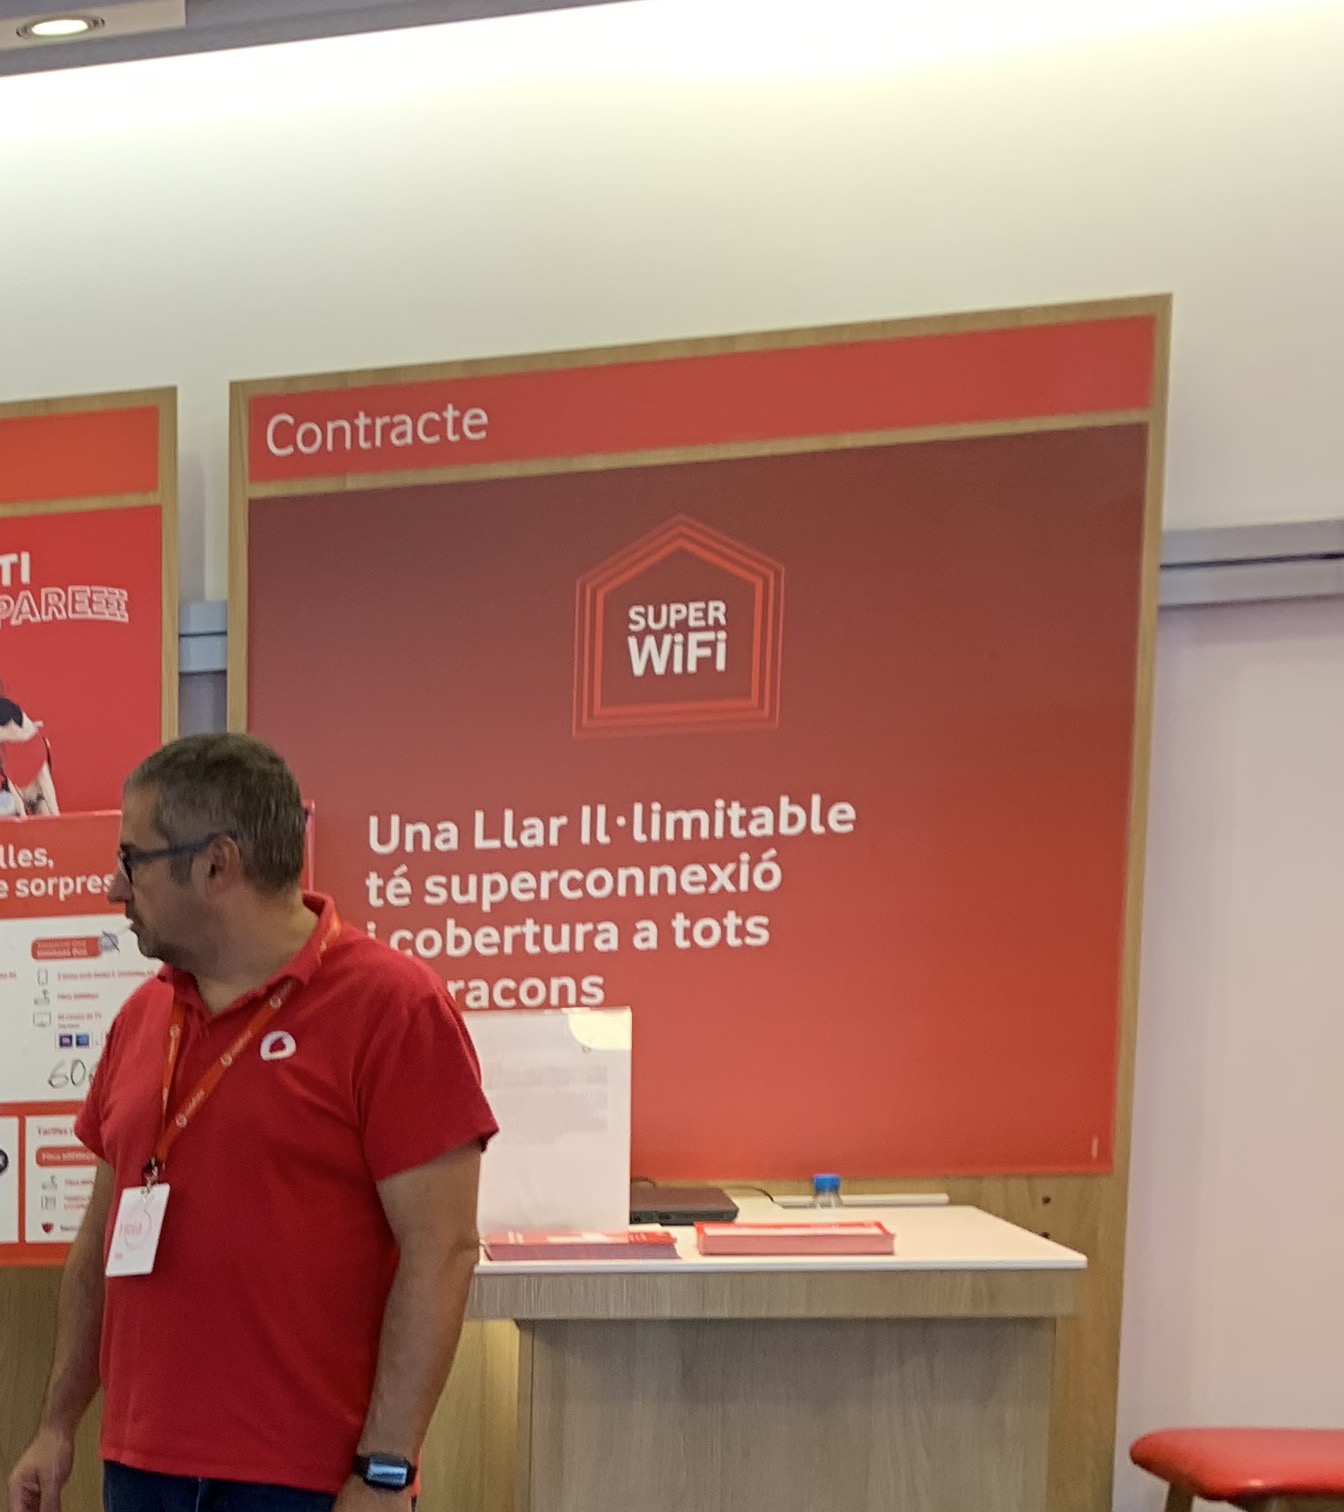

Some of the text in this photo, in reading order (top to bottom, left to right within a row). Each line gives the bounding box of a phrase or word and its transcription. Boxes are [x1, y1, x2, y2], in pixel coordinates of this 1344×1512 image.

[265, 402, 489, 458] Contracte
[627, 600, 727, 631] SUPER
[626, 631, 728, 677] WiFi
[367, 794, 857, 854] Una Llar Il·limitable
[365, 847, 783, 913] té superconnexió
[389, 916, 620, 960] cobertura
[632, 918, 658, 951] a
[671, 910, 771, 949] tots
[446, 974, 606, 1010] racons
